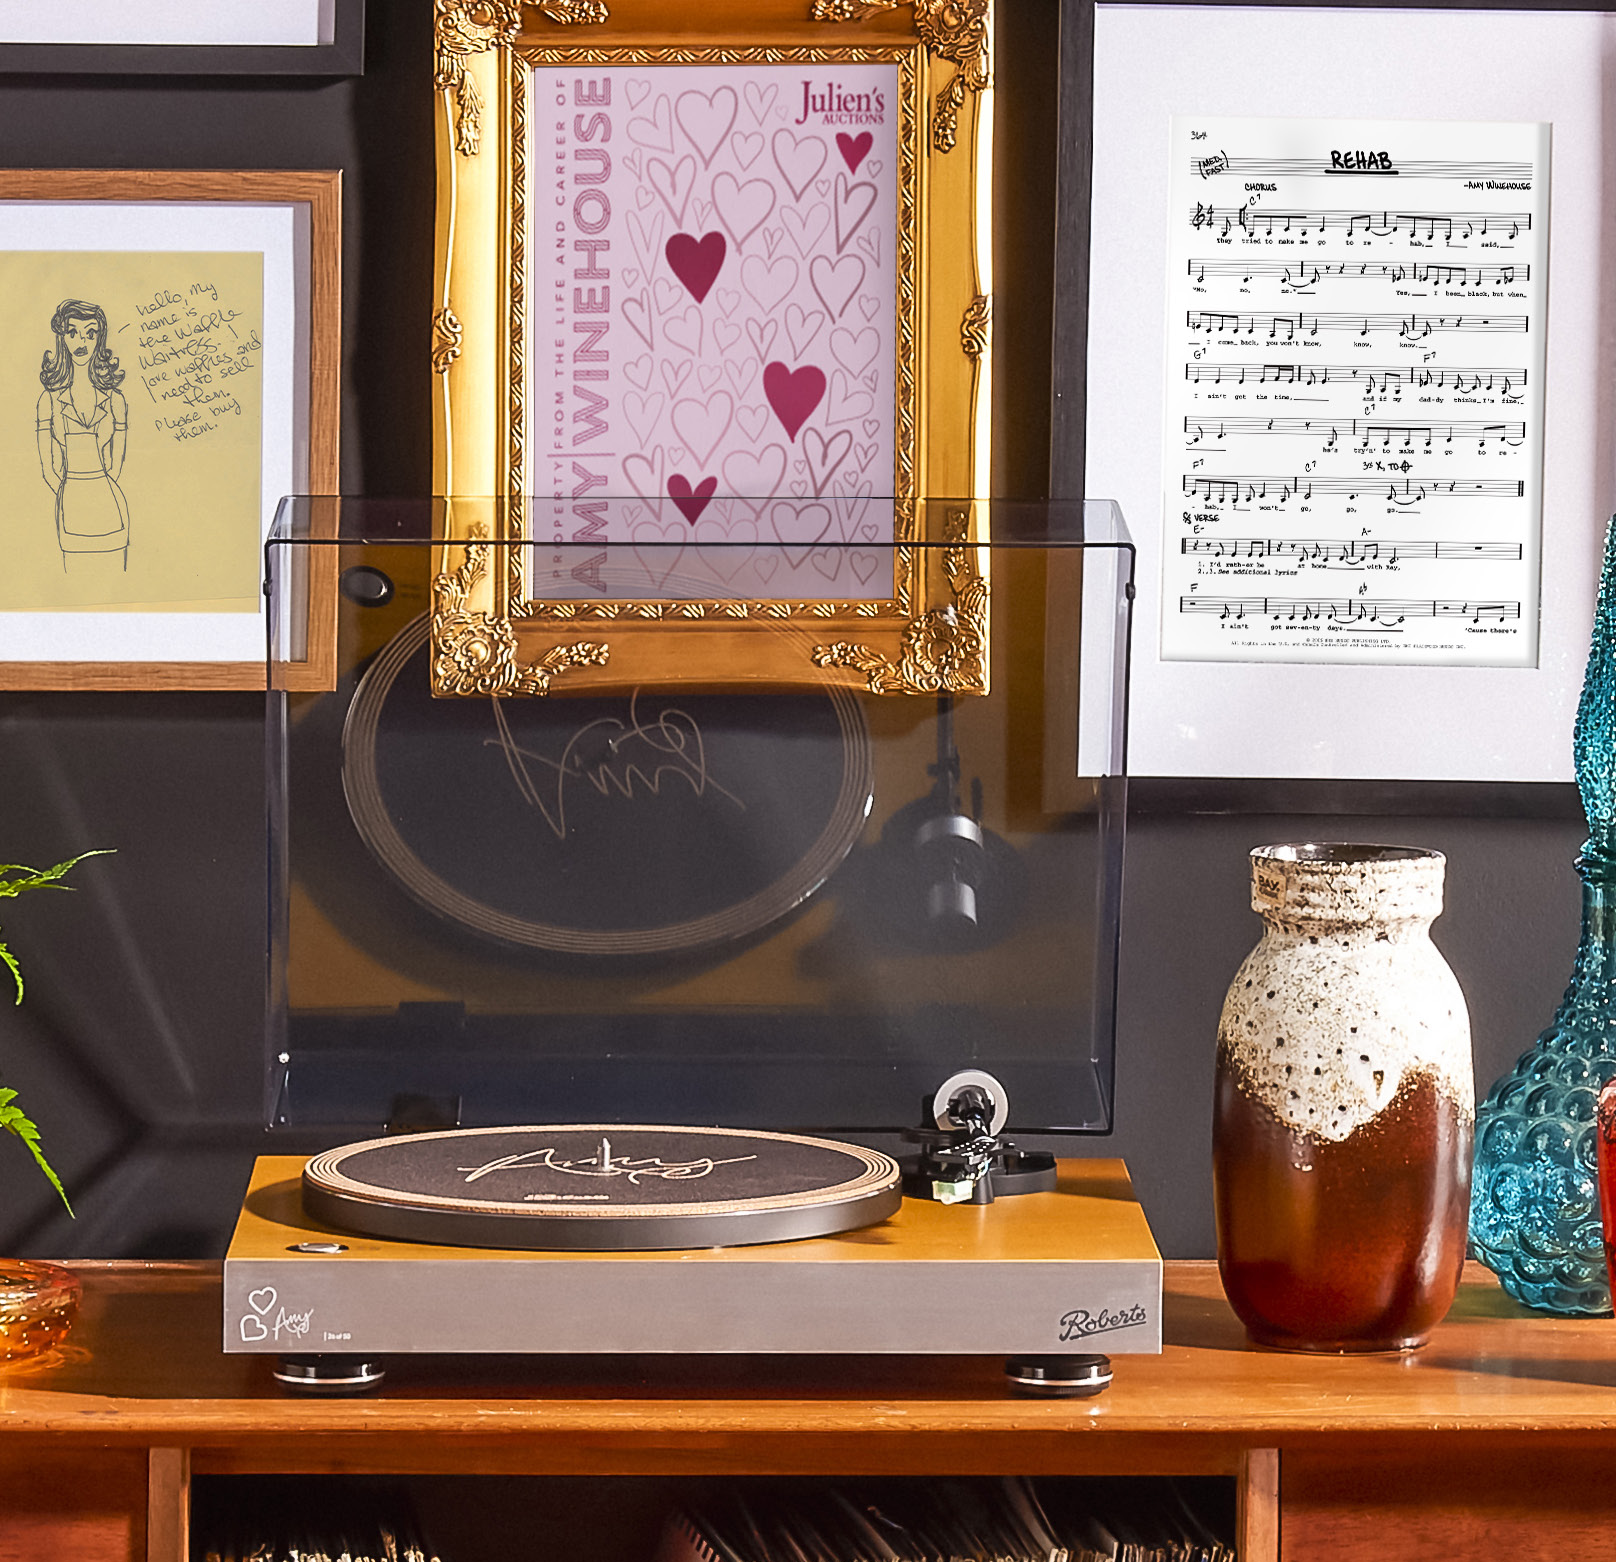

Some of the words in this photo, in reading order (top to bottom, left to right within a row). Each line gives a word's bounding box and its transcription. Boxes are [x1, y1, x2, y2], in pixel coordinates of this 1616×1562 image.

[556, 79, 566, 106] OF
[795, 80, 885, 125] Julien's
[822, 113, 884, 125] AUCTIONS
[556, 121, 566, 206] CAREER
[1330, 150, 1393, 170] REHAB
[1244, 183, 1278, 192] CHORUS
[556, 220, 566, 265] AND
[572, 77, 612, 447] WINEHOUSE
[140, 313, 182, 333] name
[185, 307, 198, 317] is
[555, 280, 565, 325] LIFE
[195, 373, 213, 385] to
[220, 356, 254, 379] sell
[555, 338, 565, 378] THE
[209, 398, 241, 415] buy
[554, 391, 565, 449] FROM
[553, 462, 564, 579] PROPERTY
[571, 461, 608, 593] AMY
[1194, 514, 1220, 522] VERSE
[1059, 1303, 1147, 1342] Roberts
